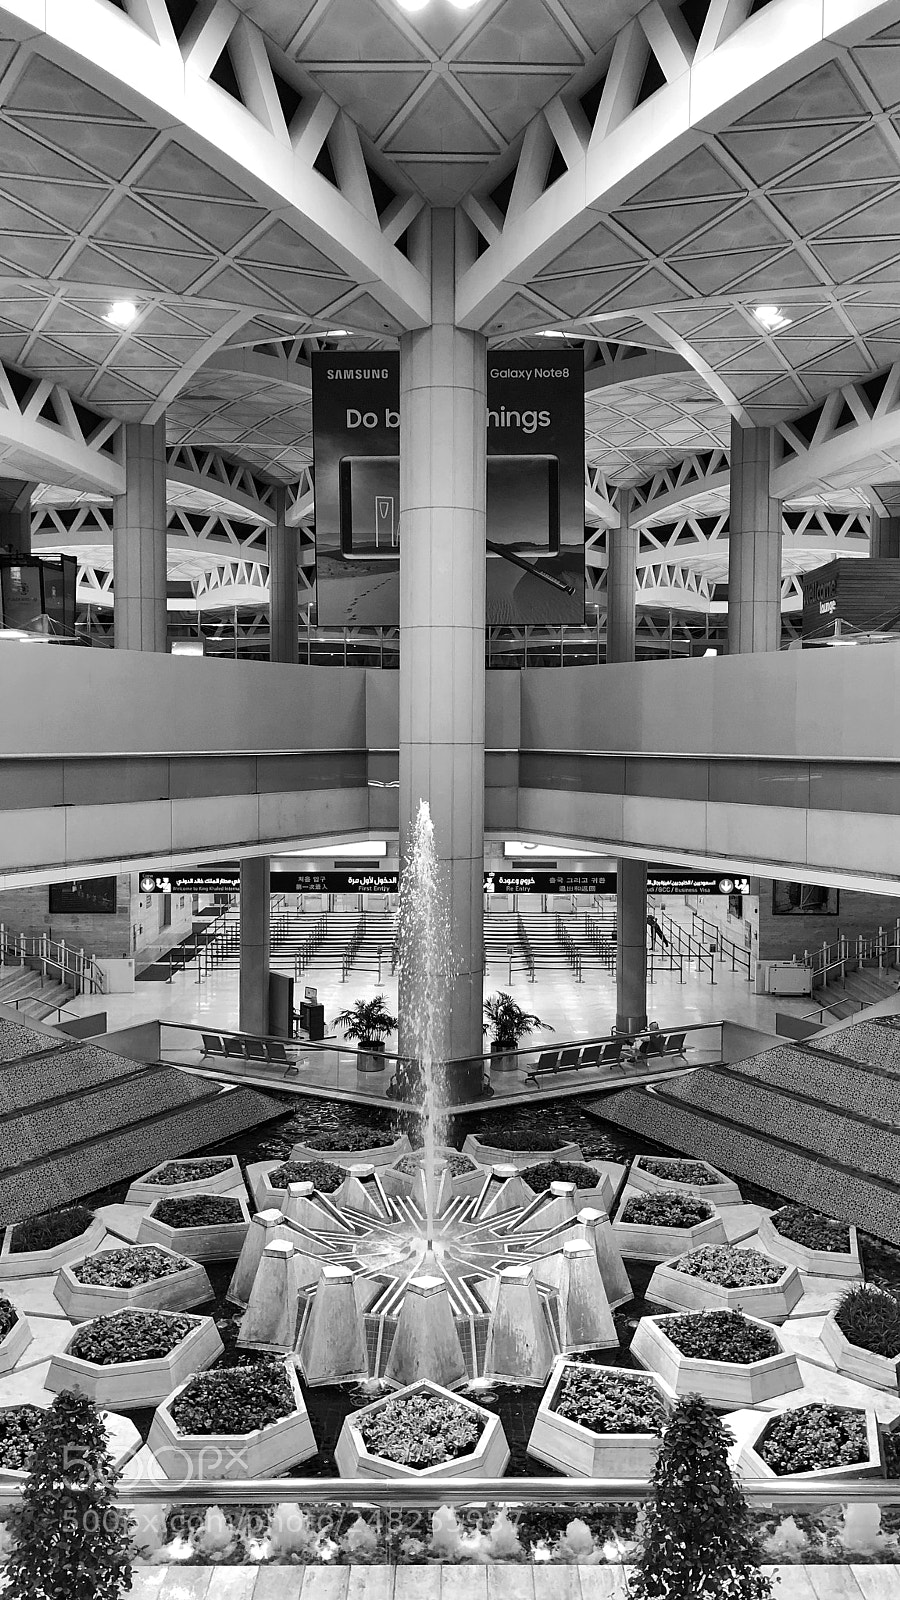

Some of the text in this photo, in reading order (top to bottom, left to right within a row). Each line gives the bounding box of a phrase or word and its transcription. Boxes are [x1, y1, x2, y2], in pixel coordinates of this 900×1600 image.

[327, 368, 389, 380] SAMSUNG
[490, 367, 570, 381] Galaxy Note8
[346, 408, 378, 429] Do
[819, 600, 837, 615] lounge
[347, 875, 397, 886] الدخول لأول مرة
[498, 876, 536, 886] خروج وعودة
[566, 876, 588, 884] 그리고
